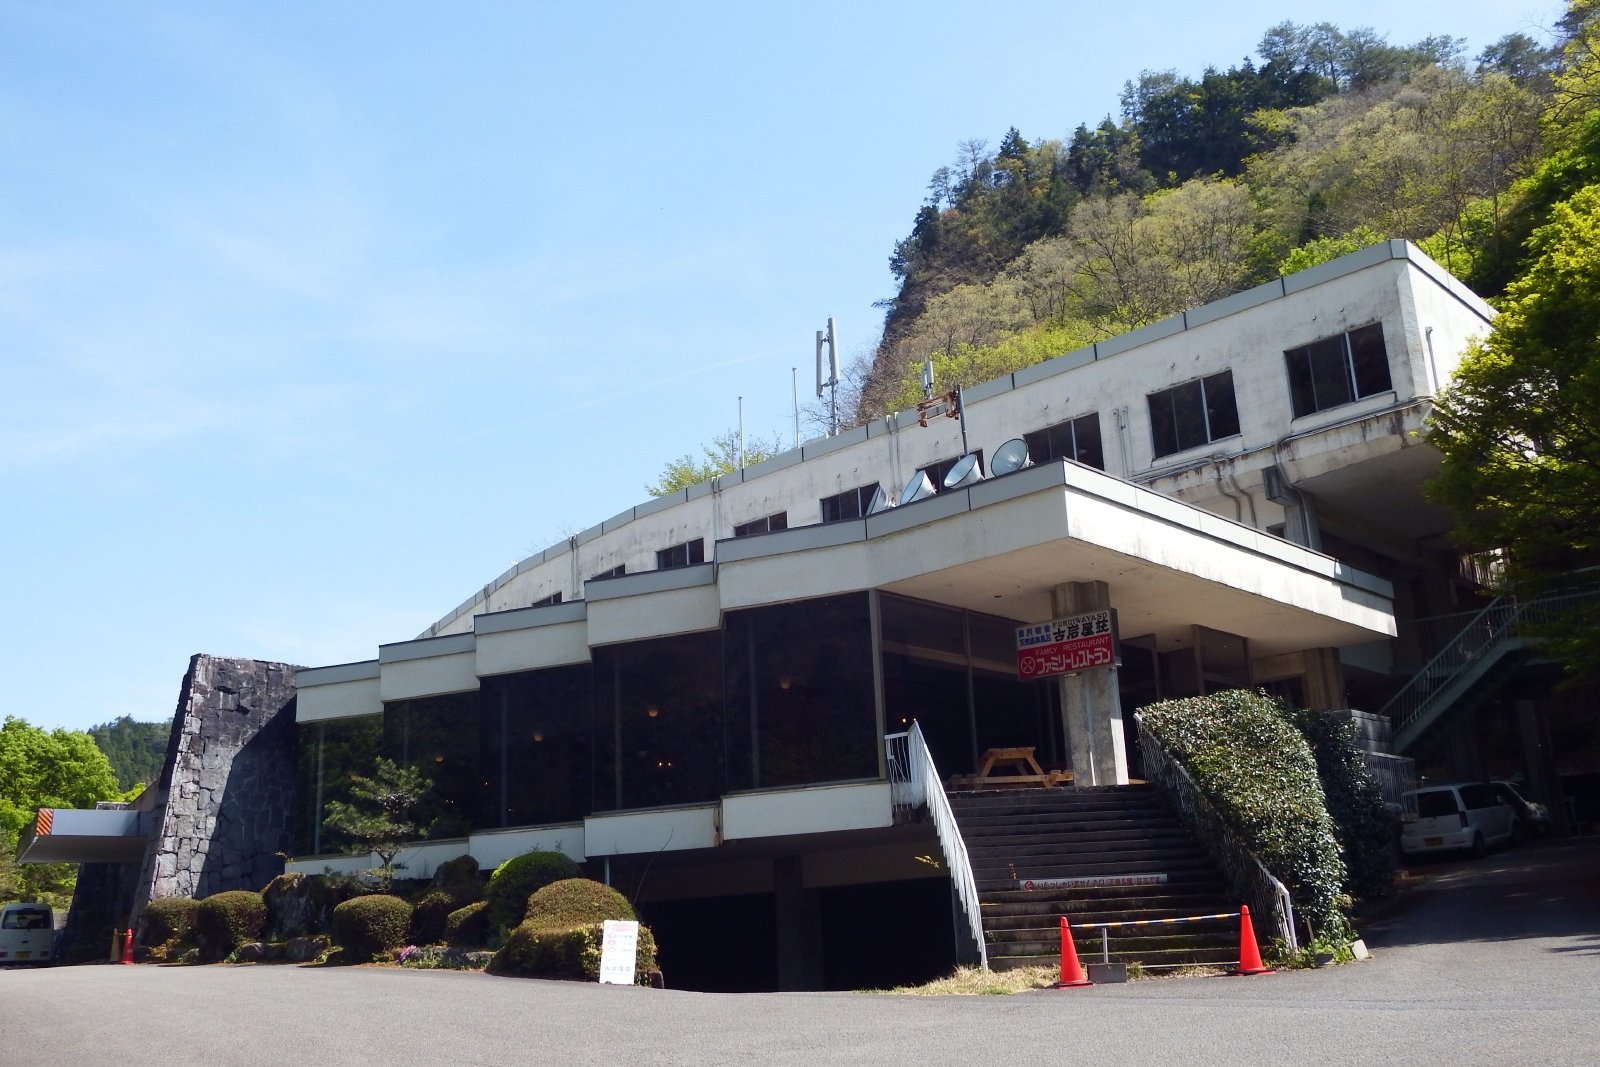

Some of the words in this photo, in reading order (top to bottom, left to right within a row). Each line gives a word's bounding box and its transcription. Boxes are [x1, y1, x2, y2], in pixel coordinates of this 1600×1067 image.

[1053, 612, 1108, 628] FURUIWAYASO
[1053, 619, 1110, 642] 古岩屋荘
[1035, 646, 1058, 656] FAMILY
[1062, 637, 1109, 651] RESTAURANT
[1036, 647, 1111, 675] ファミリーレストラン
